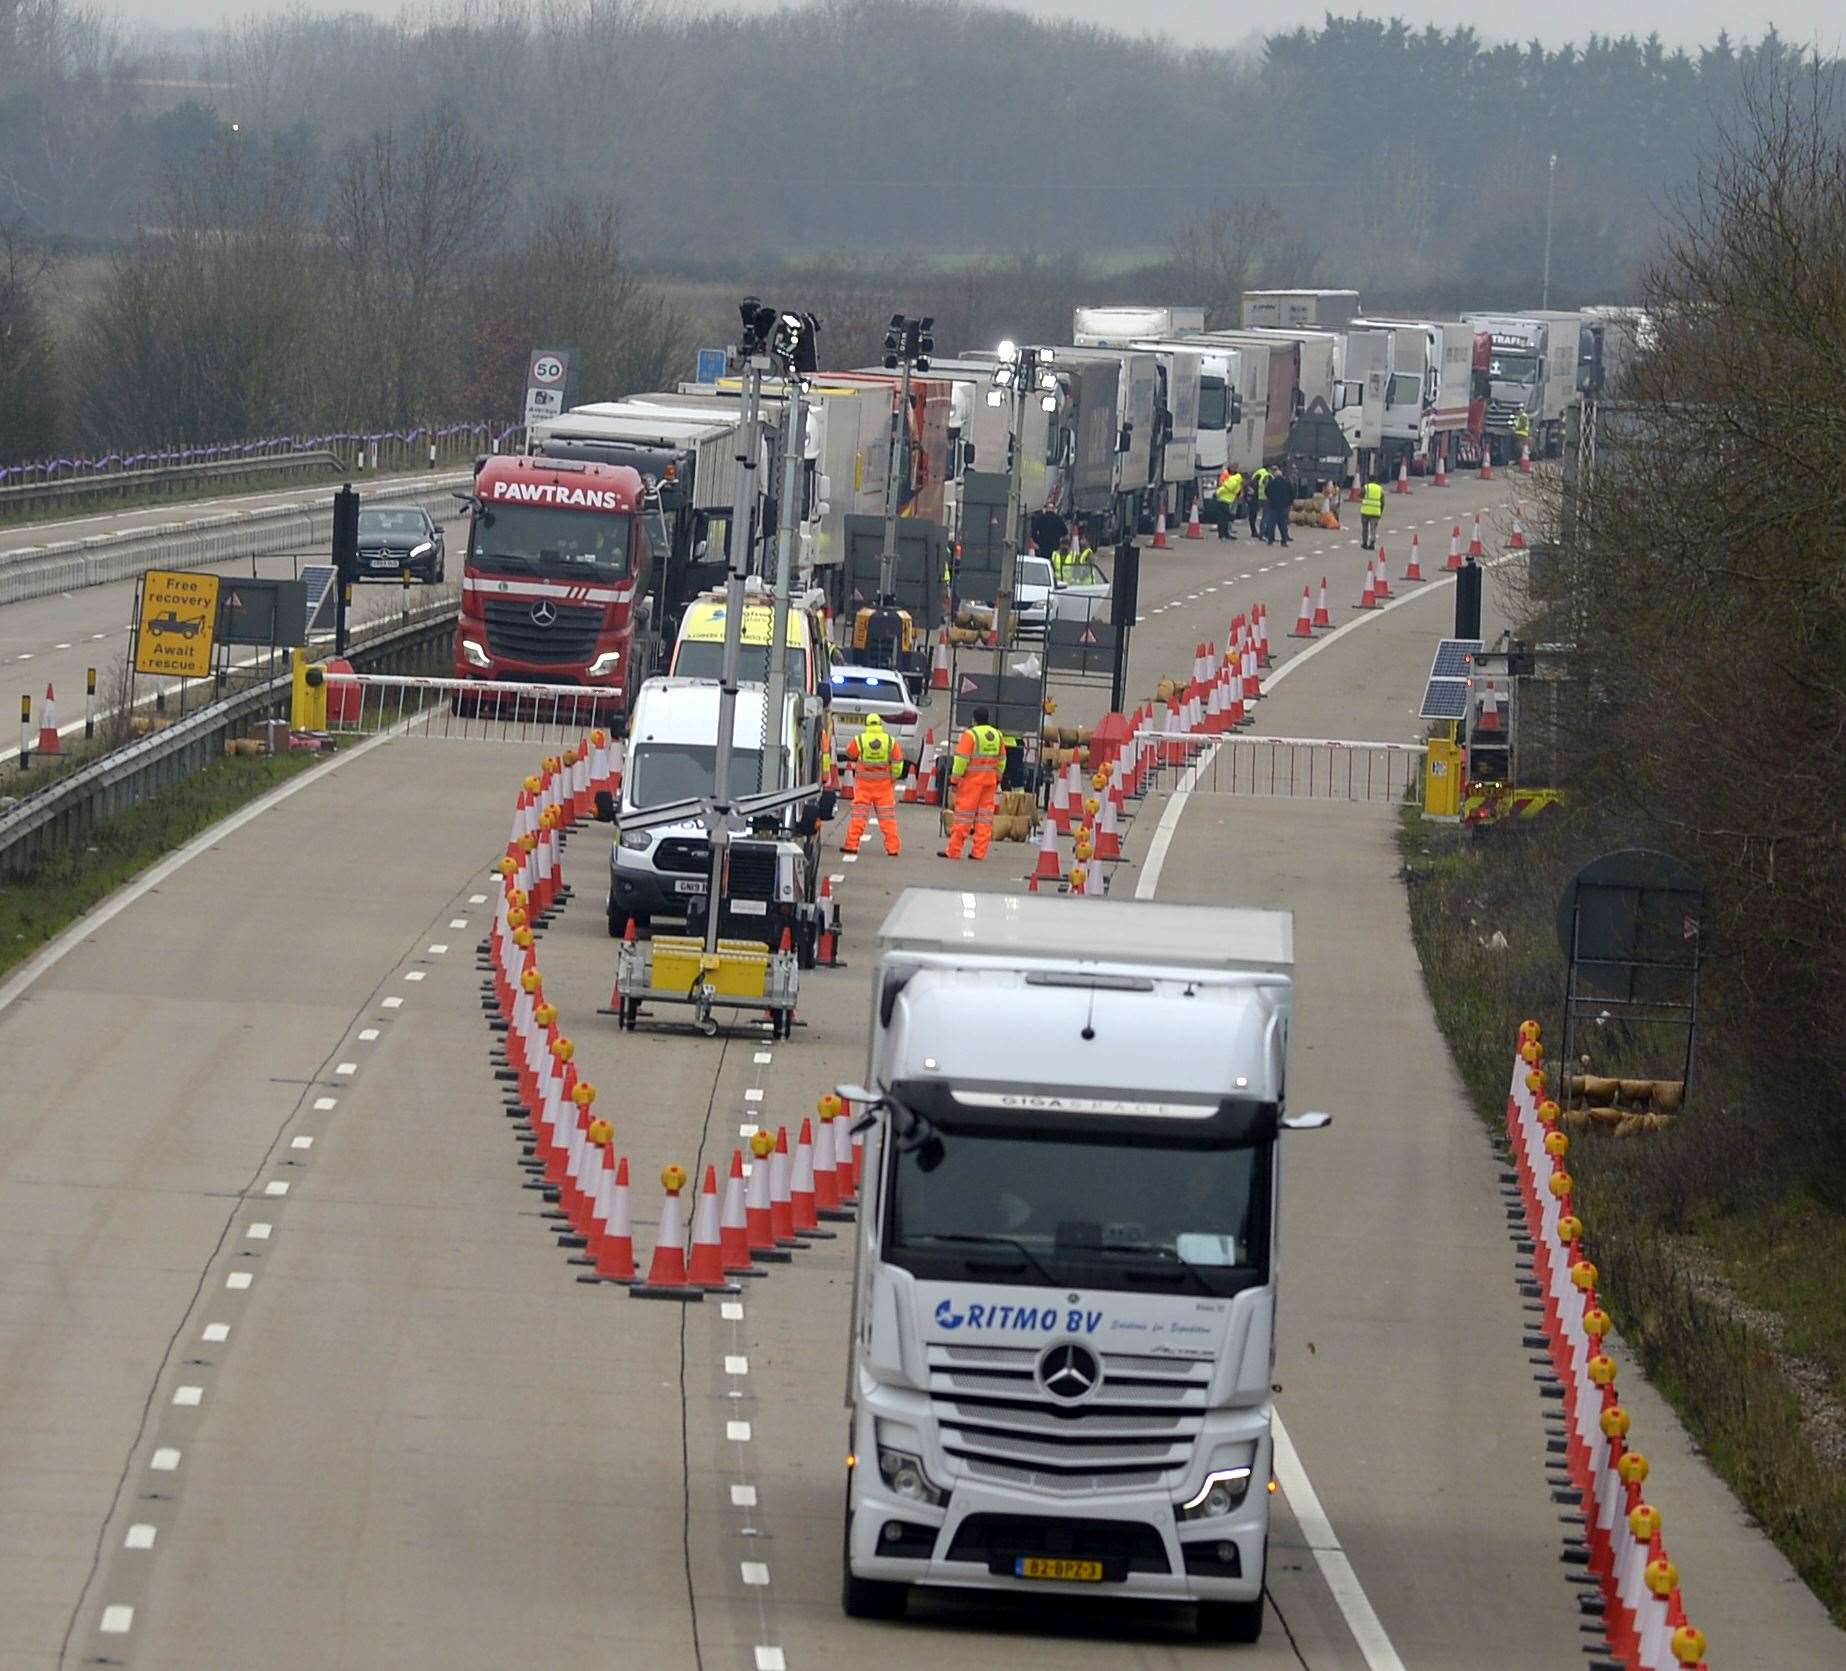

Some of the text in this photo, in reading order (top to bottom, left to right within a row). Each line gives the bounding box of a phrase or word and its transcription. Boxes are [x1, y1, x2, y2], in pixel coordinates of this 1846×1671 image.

[537, 364, 560, 377] 50
[494, 481, 616, 509] PAWTRANS
[166, 578, 198, 591] Free
[148, 592, 211, 608] recovery
[153, 643, 194, 657] Await
[148, 659, 195, 670] rescue
[967, 1304, 1057, 1333] RITMO
[1066, 1311, 1103, 1334] BV
